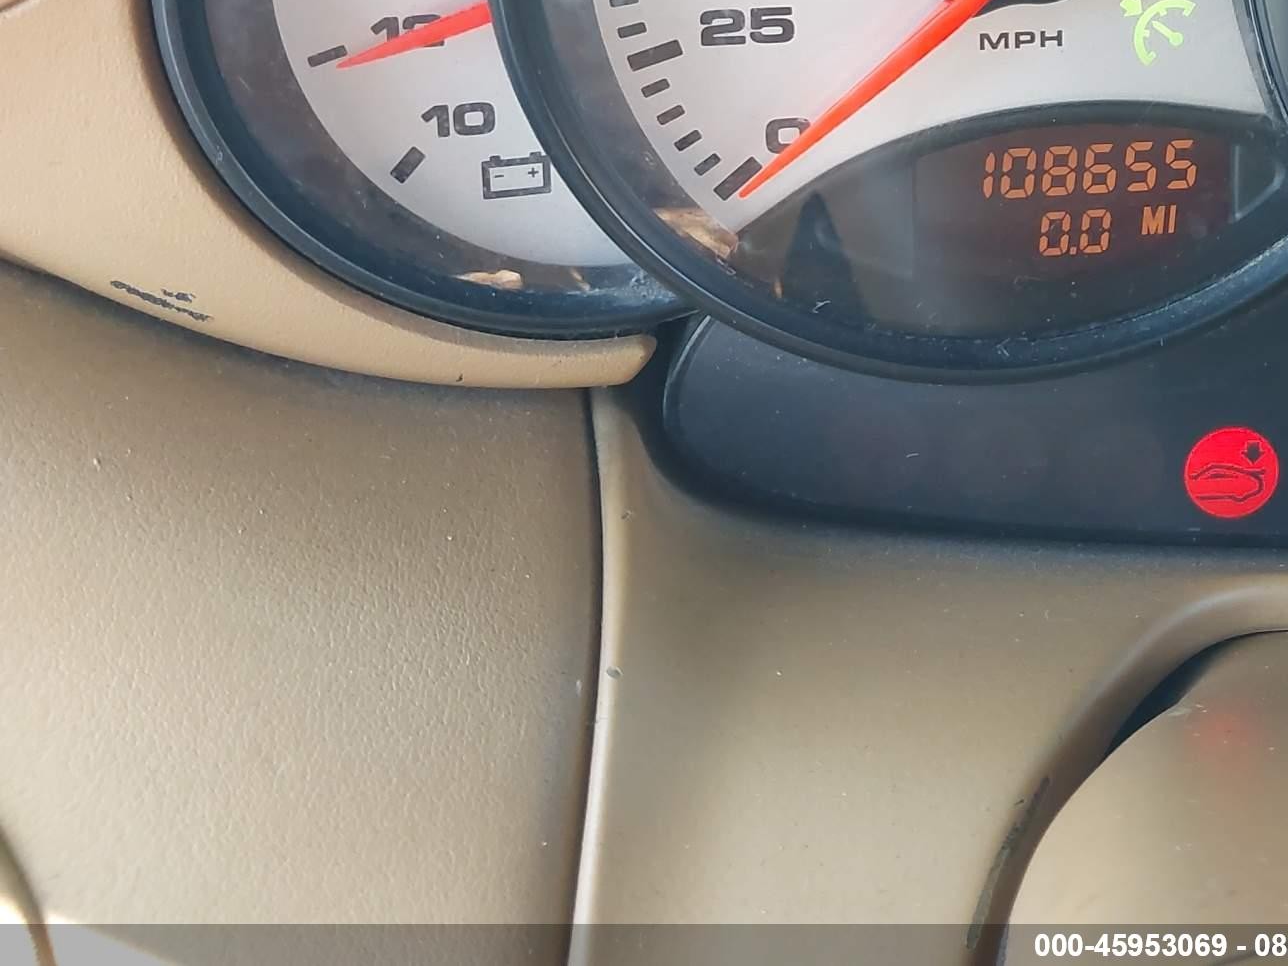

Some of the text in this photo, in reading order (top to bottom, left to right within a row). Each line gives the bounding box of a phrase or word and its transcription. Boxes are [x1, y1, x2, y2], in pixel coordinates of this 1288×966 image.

[700, 7, 795, 45] 25
[979, 30, 1064, 50] MPH
[422, 101, 496, 137] 10
[982, 138, 1198, 199] 108655
[1039, 204, 1177, 257] 0.0 MI
